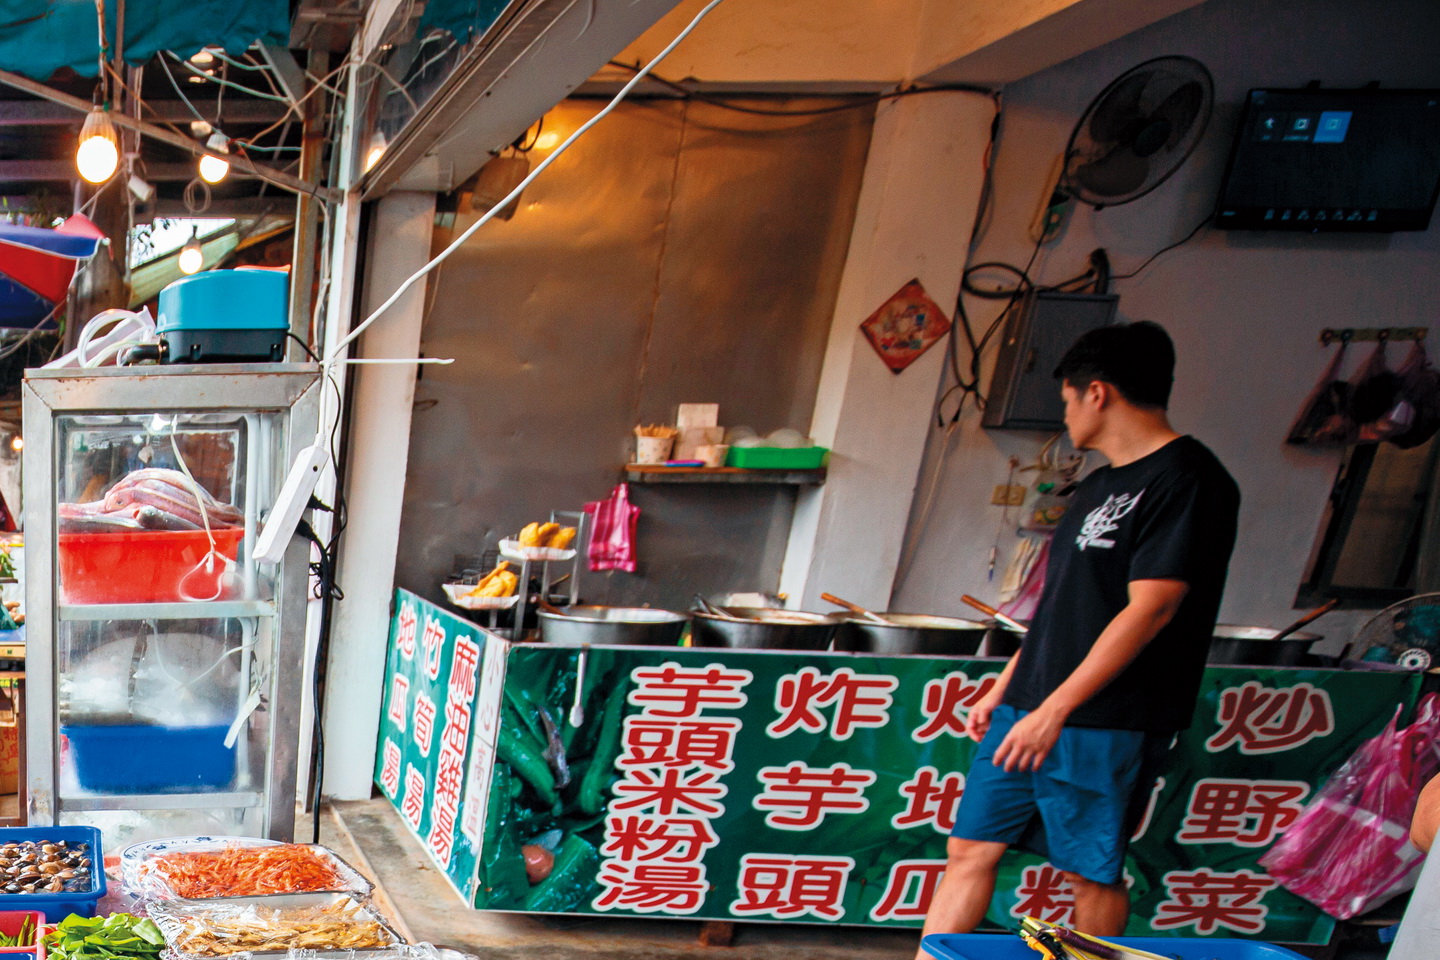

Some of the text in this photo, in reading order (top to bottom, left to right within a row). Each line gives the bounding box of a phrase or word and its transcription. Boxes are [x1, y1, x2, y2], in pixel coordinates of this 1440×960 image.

[380, 601, 417, 799] 地瓜湯
[403, 615, 445, 831] 竹筍湯
[428, 635, 479, 871] 麻油雞湯
[593, 663, 753, 914] 芋頭米粉湯
[730, 667, 898, 921] 炸芋頭
[1151, 681, 1335, 935] 炒野菜
